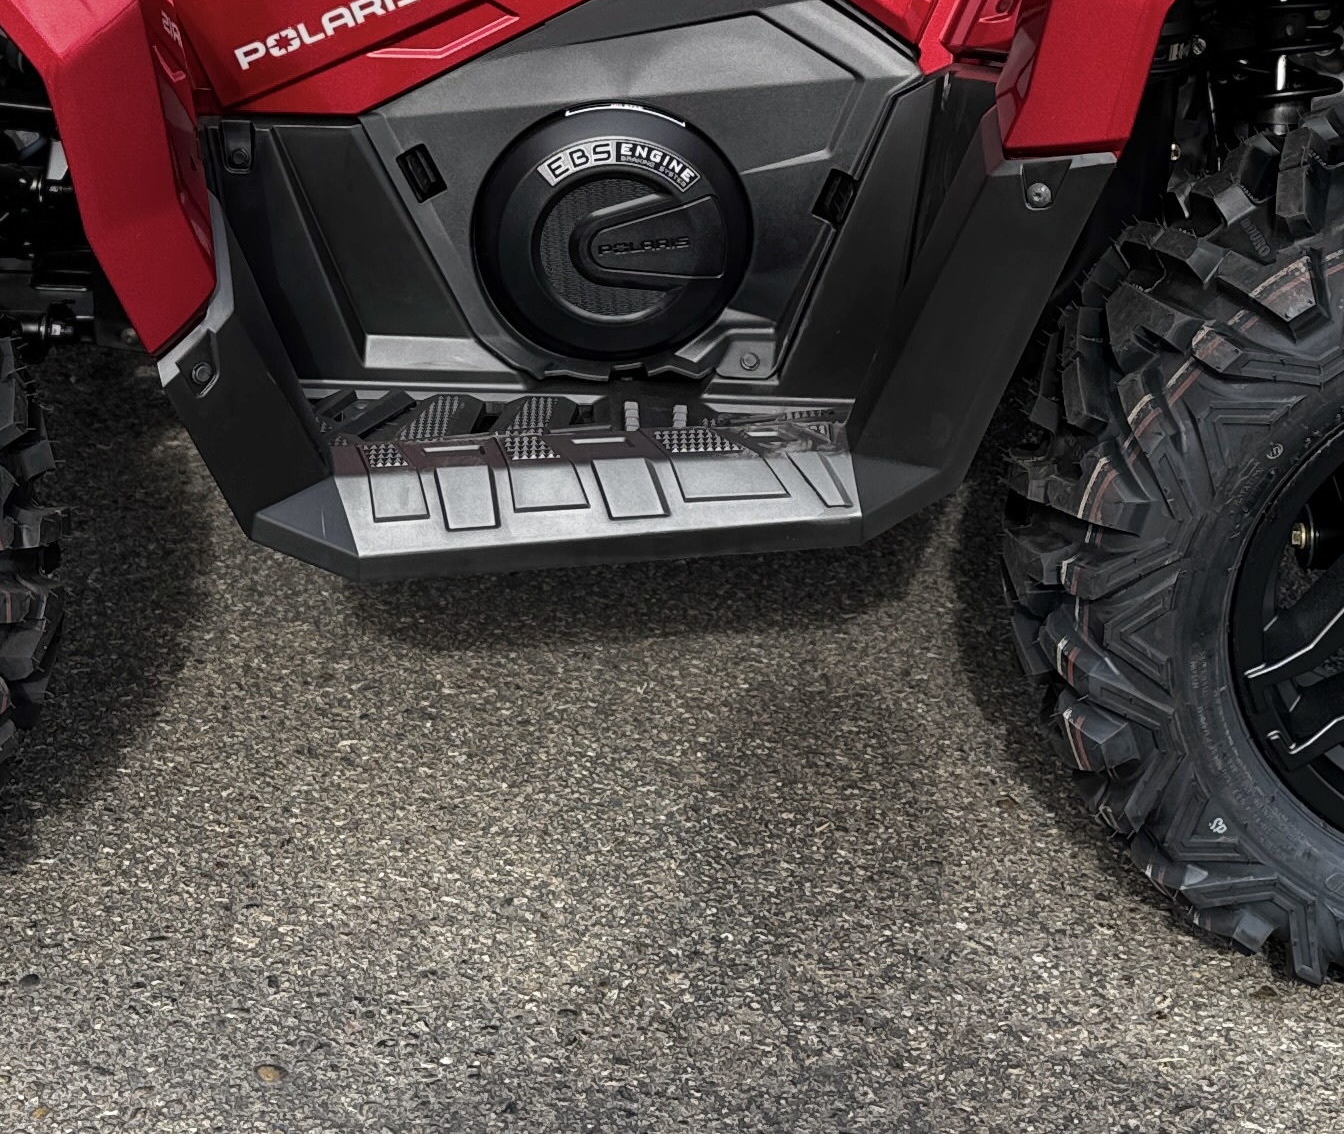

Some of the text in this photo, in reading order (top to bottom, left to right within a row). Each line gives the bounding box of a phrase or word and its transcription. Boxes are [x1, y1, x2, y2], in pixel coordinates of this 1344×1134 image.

[546, 142, 696, 183] EBS ENGINE
[620, 155, 655, 168] BRAKING
[597, 236, 691, 257] POLARIS
